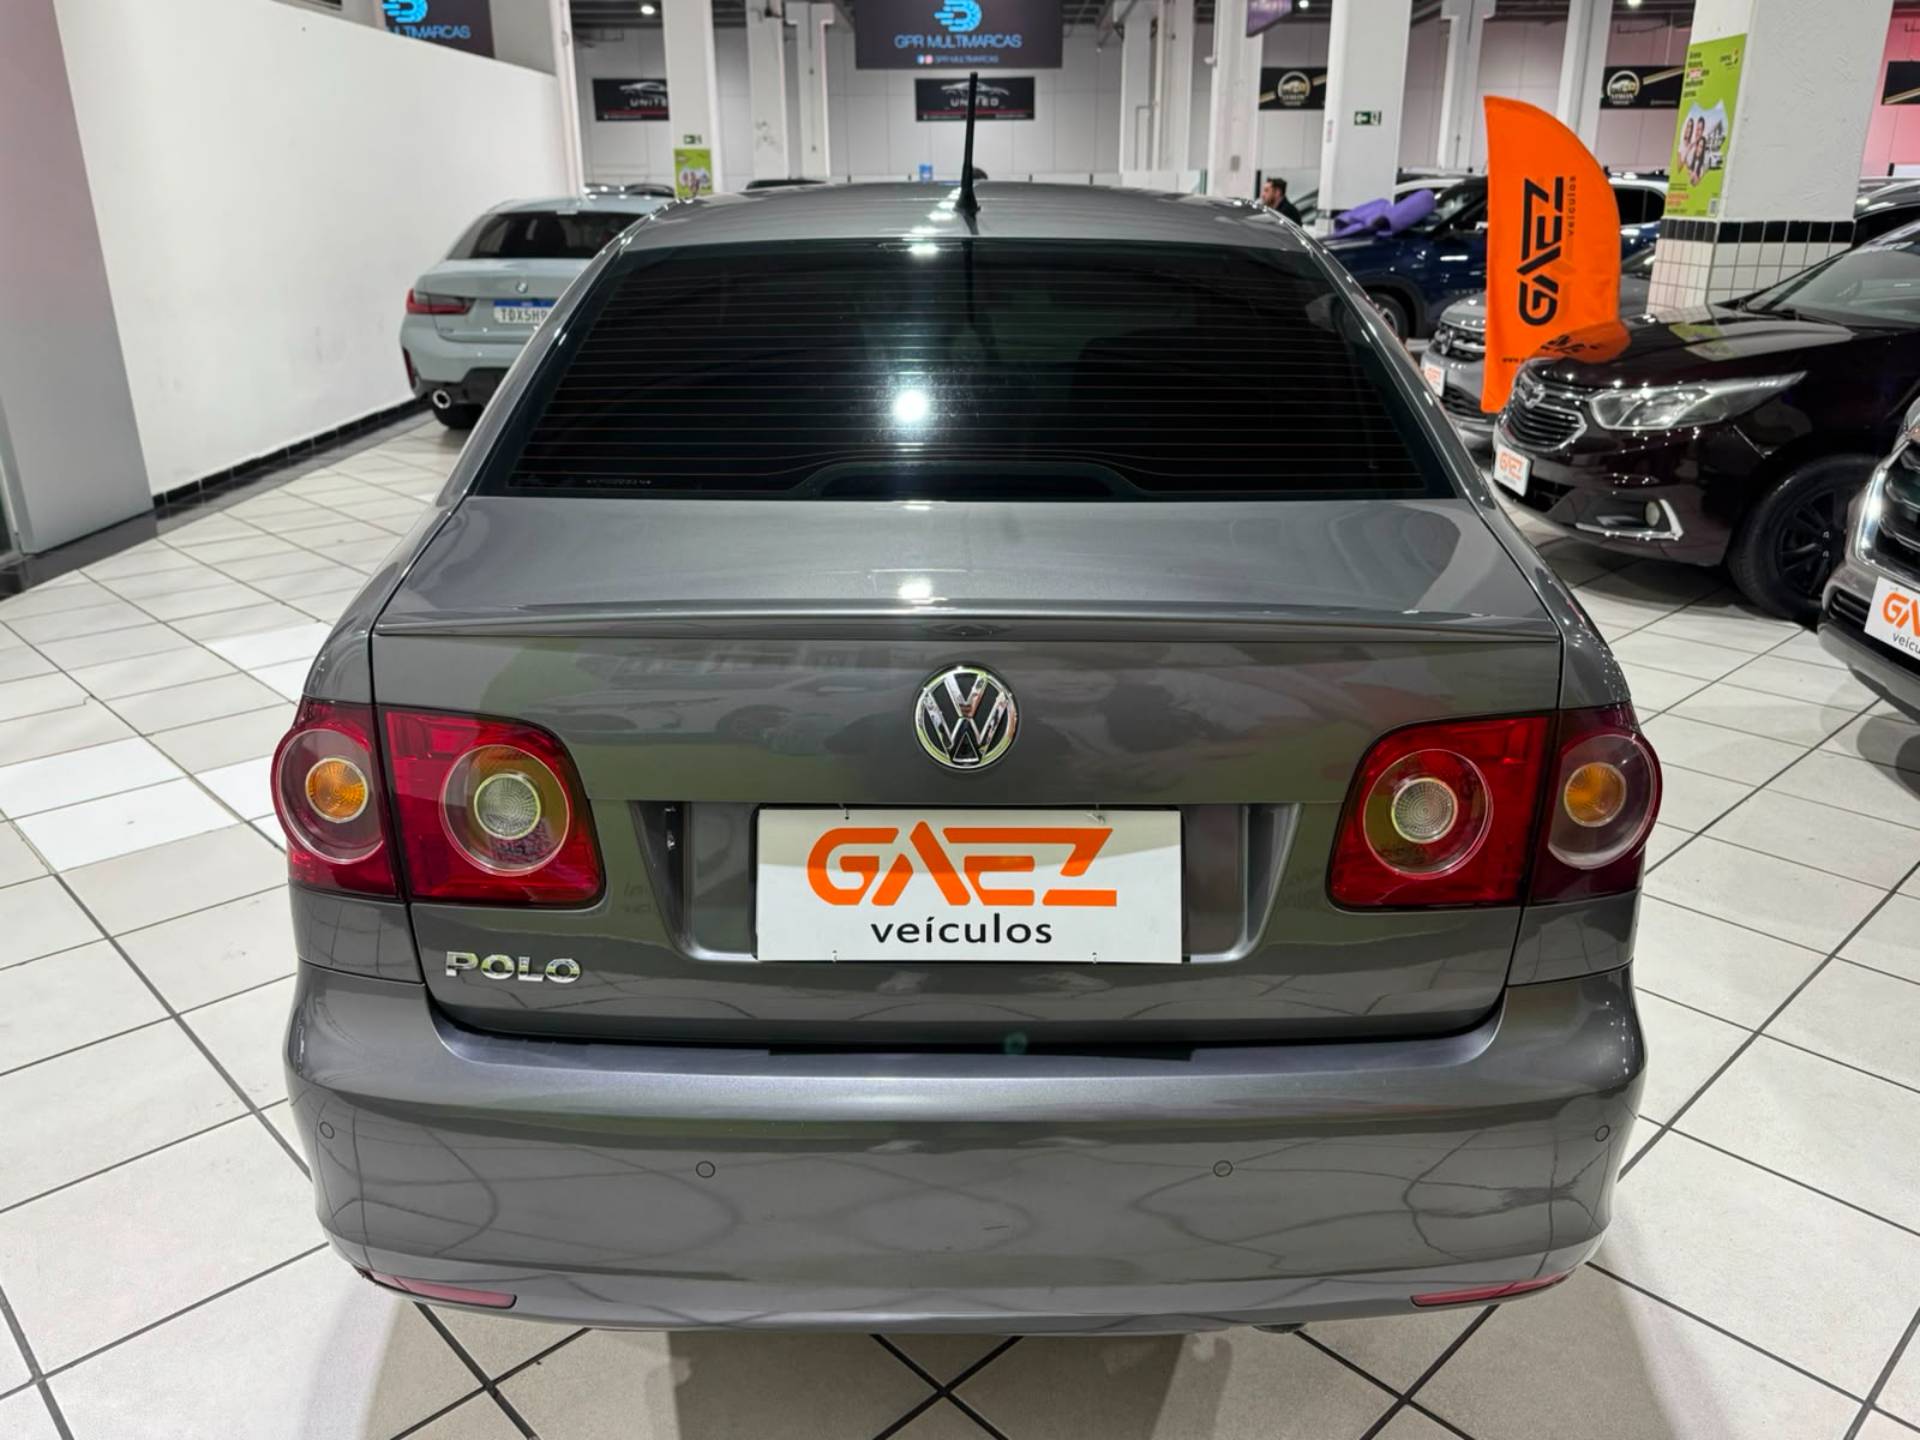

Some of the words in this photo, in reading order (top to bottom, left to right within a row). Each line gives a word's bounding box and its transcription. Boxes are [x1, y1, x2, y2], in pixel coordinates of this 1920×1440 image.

[894, 34, 924, 48] GPR
[927, 34, 1022, 48] MULTIMARCAS
[1516, 177, 1565, 327] GAEZ
[806, 820, 1118, 908] GAEZ
[871, 912, 1054, 944] veículos
[445, 951, 581, 984] POLO
